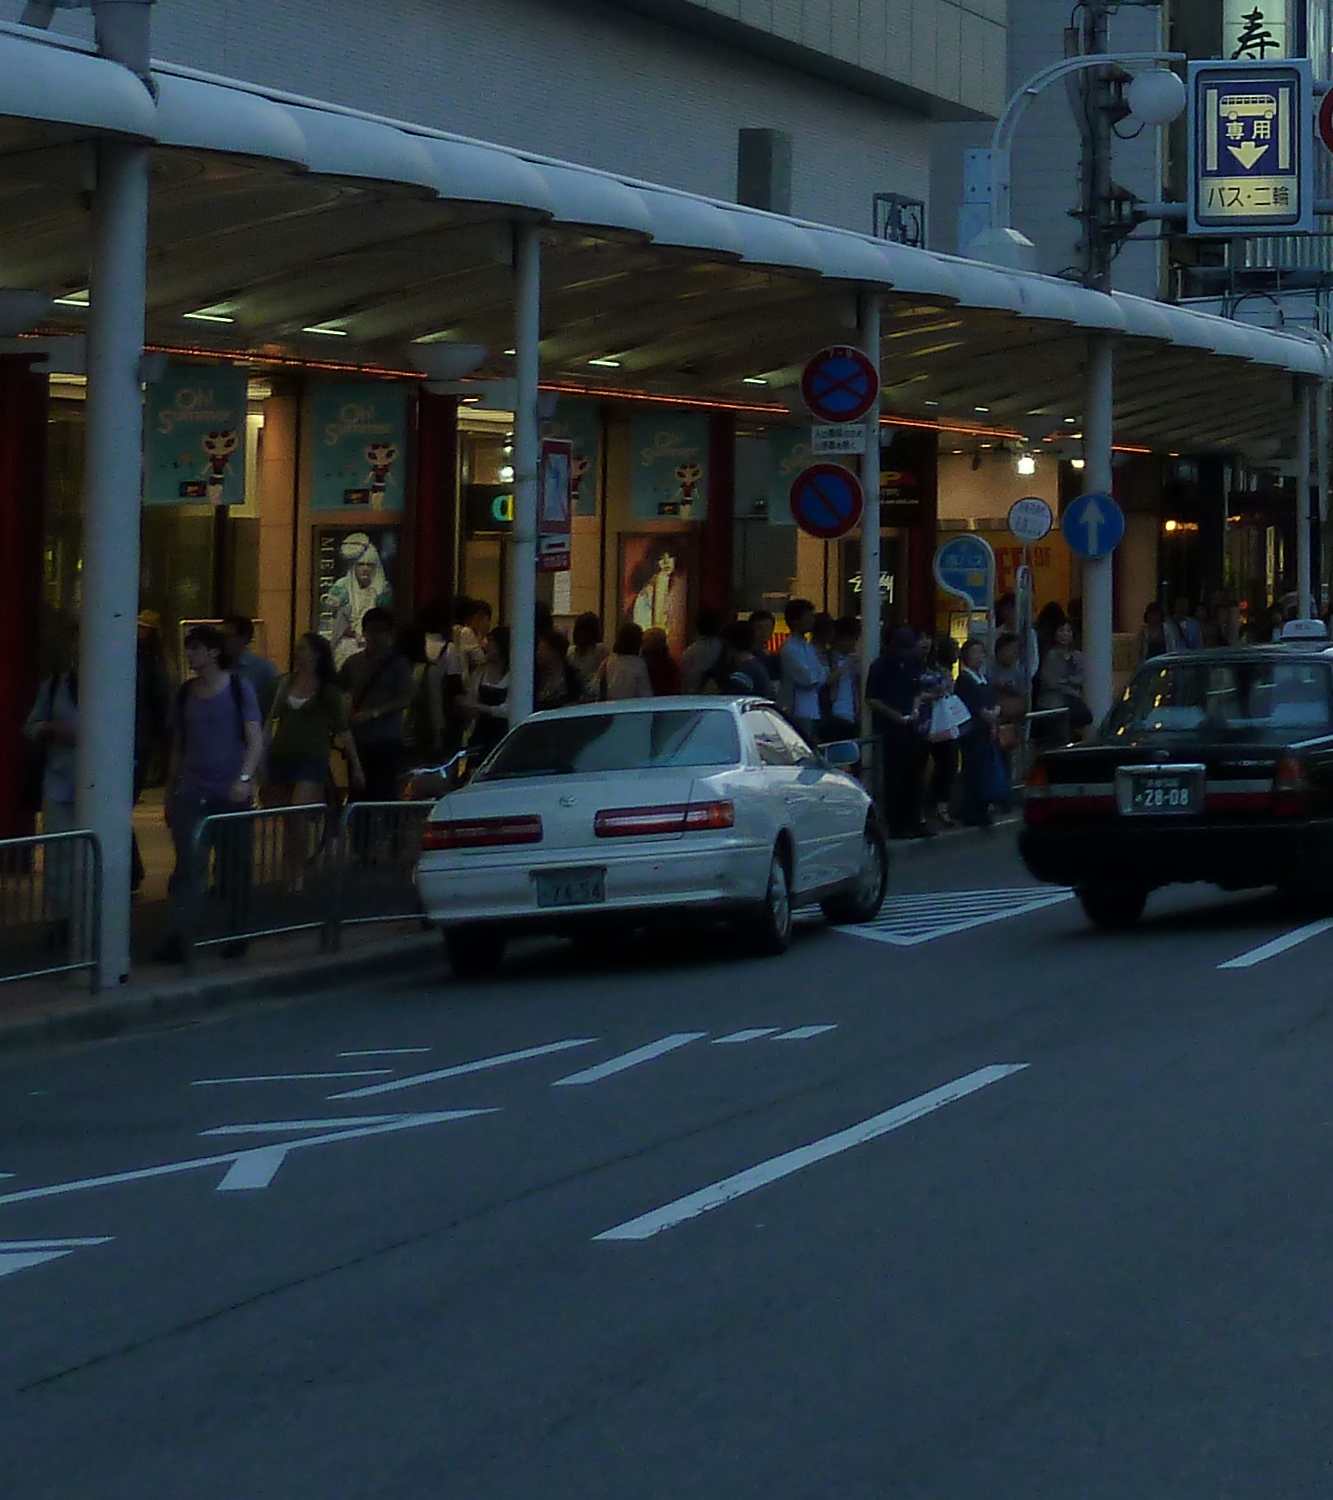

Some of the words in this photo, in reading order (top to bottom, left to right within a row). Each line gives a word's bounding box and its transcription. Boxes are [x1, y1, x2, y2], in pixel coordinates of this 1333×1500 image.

[1224, 119, 1273, 141] 専用
[1207, 185, 1289, 209] バス・二輪
